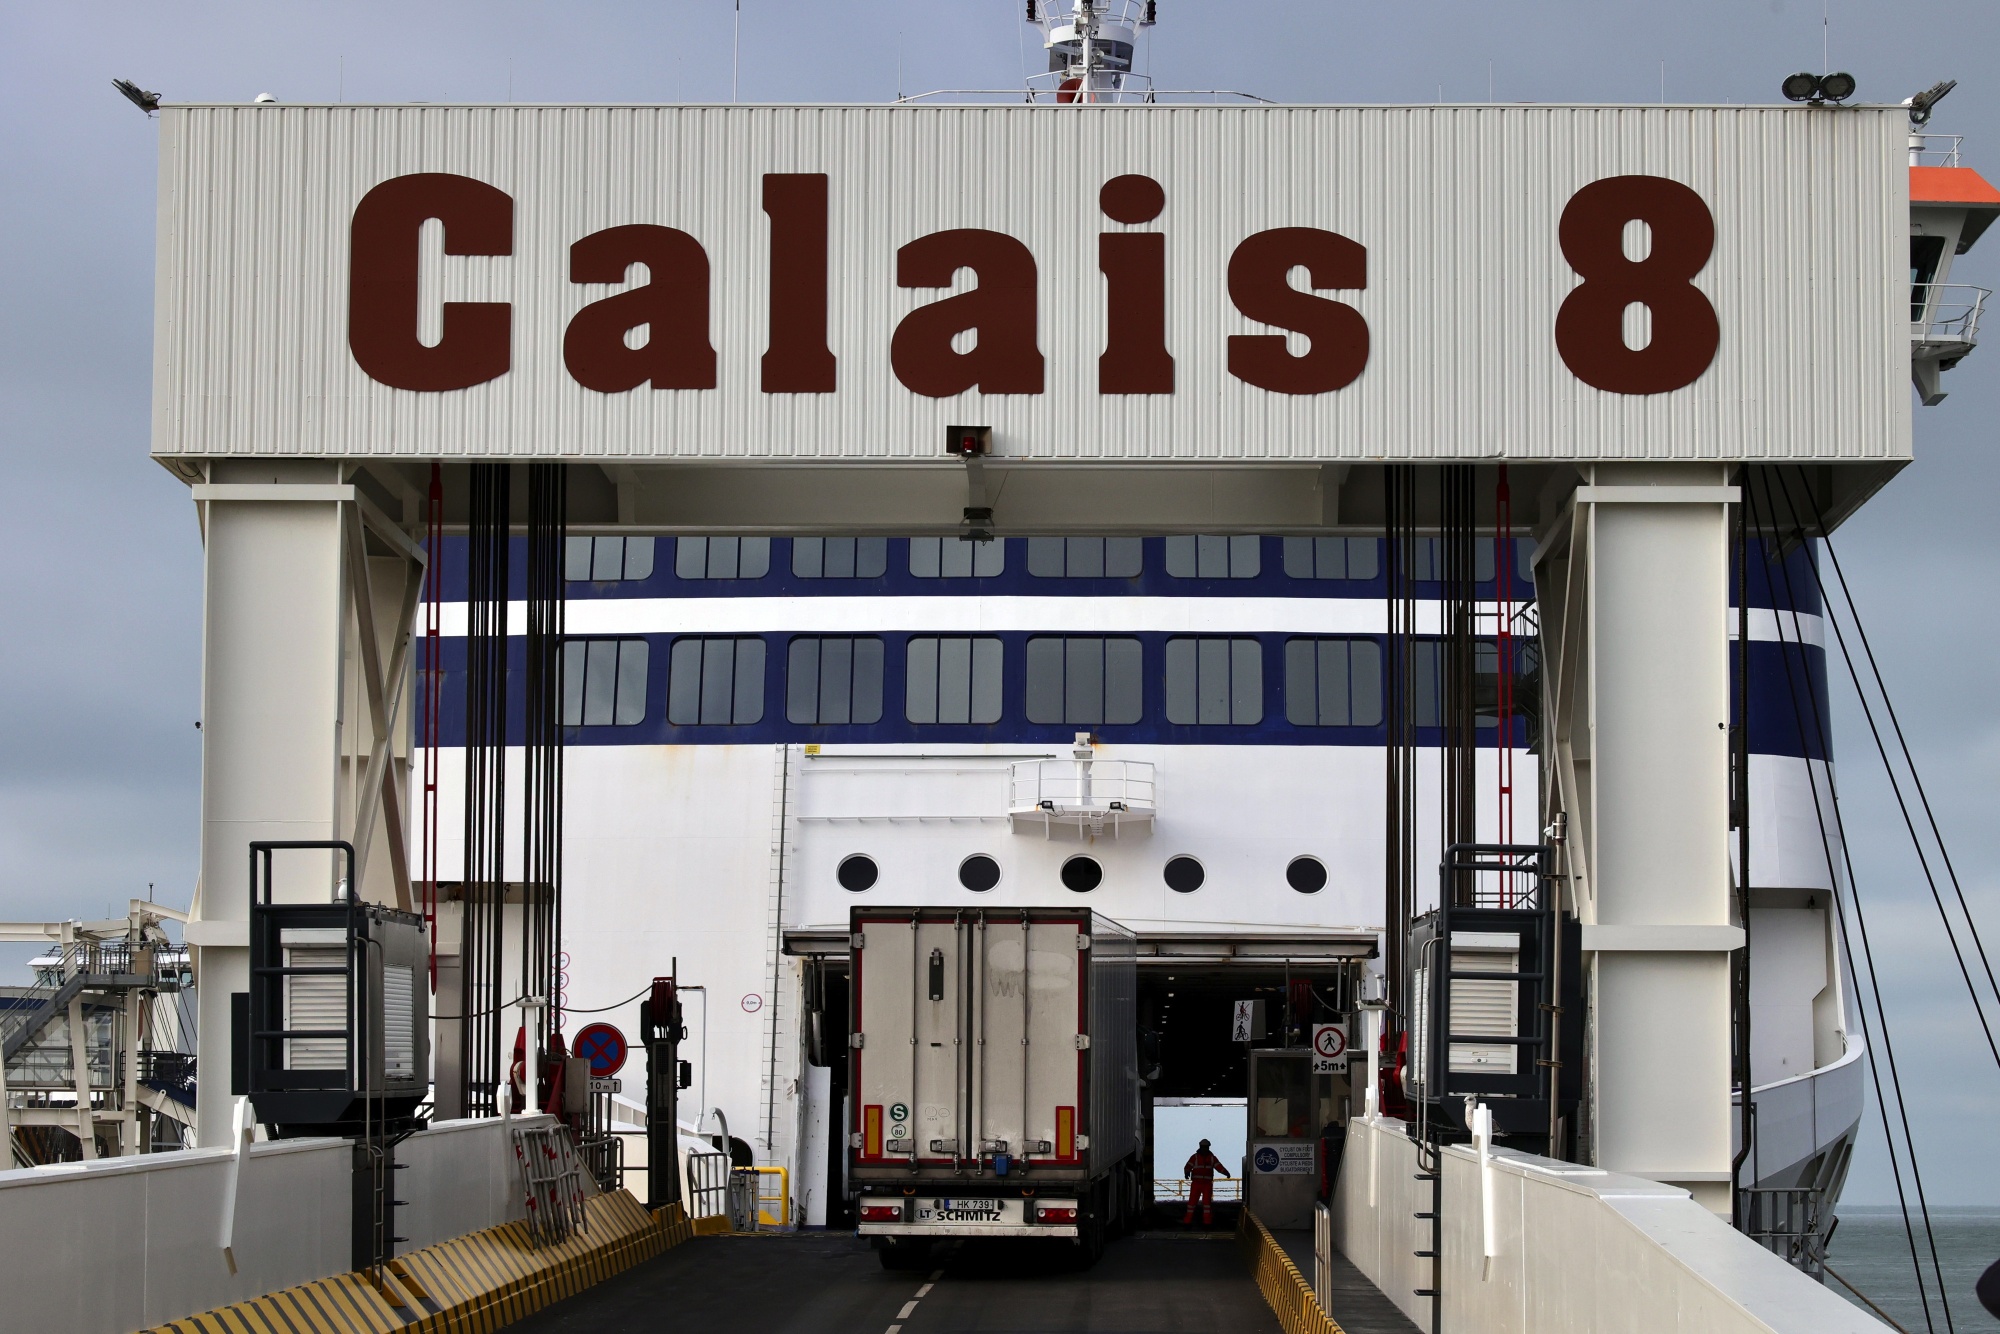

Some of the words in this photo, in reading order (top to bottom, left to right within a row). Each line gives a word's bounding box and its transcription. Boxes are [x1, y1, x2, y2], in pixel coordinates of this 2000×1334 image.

[348, 173, 1370, 397] Calais
[1555, 175, 1719, 395] 8
[1320, 1060, 1339, 1071] 5m
[893, 1105, 905, 1120] S
[957, 1200, 970, 1209] HK
[972, 1200, 990, 1209] 739
[920, 1209, 931, 1218] LT
[936, 1210, 1001, 1221] SCHMITZ
